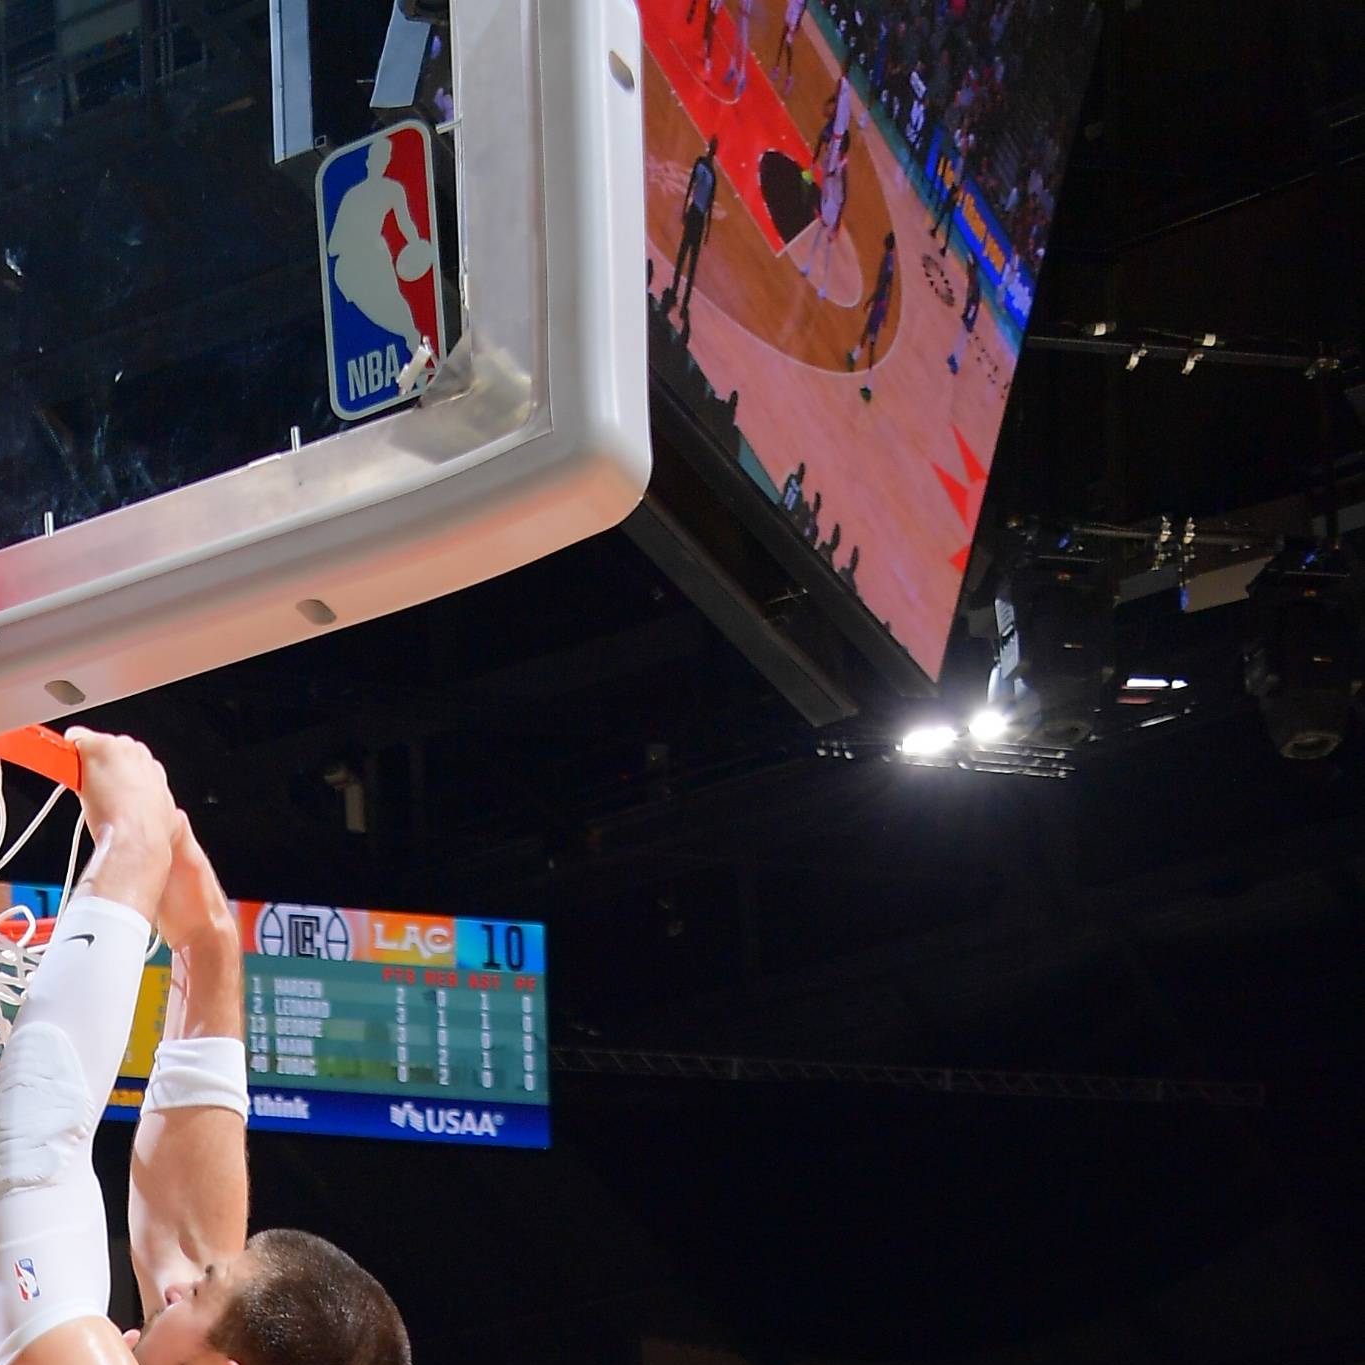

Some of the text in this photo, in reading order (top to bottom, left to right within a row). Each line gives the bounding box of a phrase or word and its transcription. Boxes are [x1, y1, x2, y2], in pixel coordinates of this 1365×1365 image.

[347, 344, 401, 401] NBA
[374, 922, 452, 958] LAC
[481, 923, 524, 972] 10
[382, 966, 416, 985] PTS
[468, 973, 500, 992] AST
[254, 1095, 310, 1119] think
